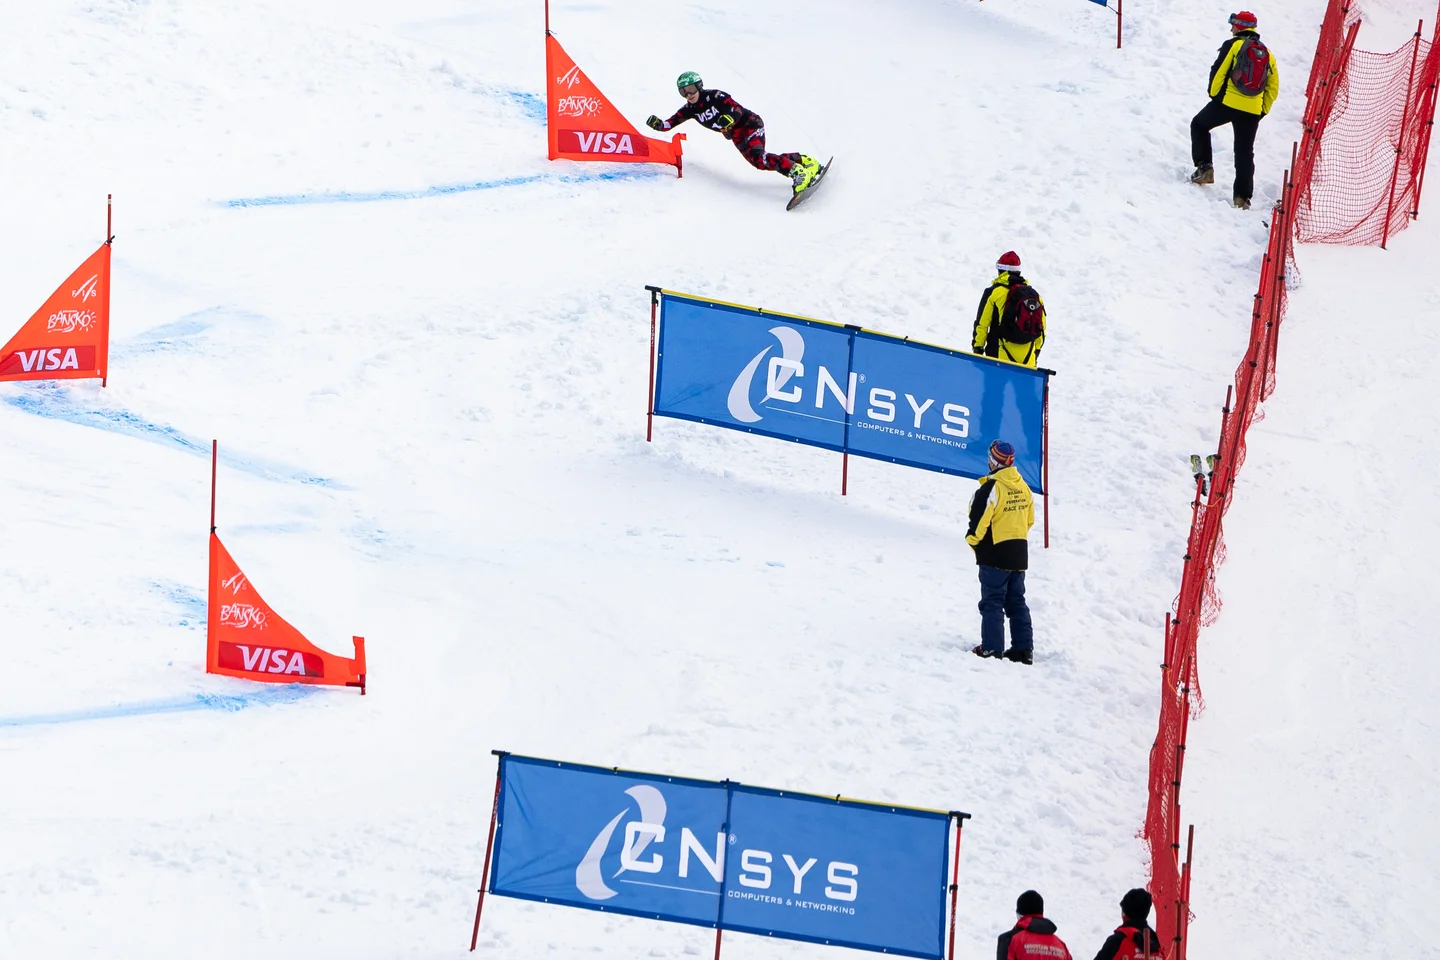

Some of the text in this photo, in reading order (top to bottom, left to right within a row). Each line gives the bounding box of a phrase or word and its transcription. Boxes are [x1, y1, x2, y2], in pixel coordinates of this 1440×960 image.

[695, 106, 720, 122] VISA
[573, 132, 634, 154] VISA
[14, 348, 78, 372] VISA
[857, 422, 905, 436] COMPUTERS
[916, 434, 968, 450] NETWORKING
[236, 644, 306, 676] VISA
[728, 890, 782, 904] COMPUTERS
[795, 900, 856, 916] NETWORKING
